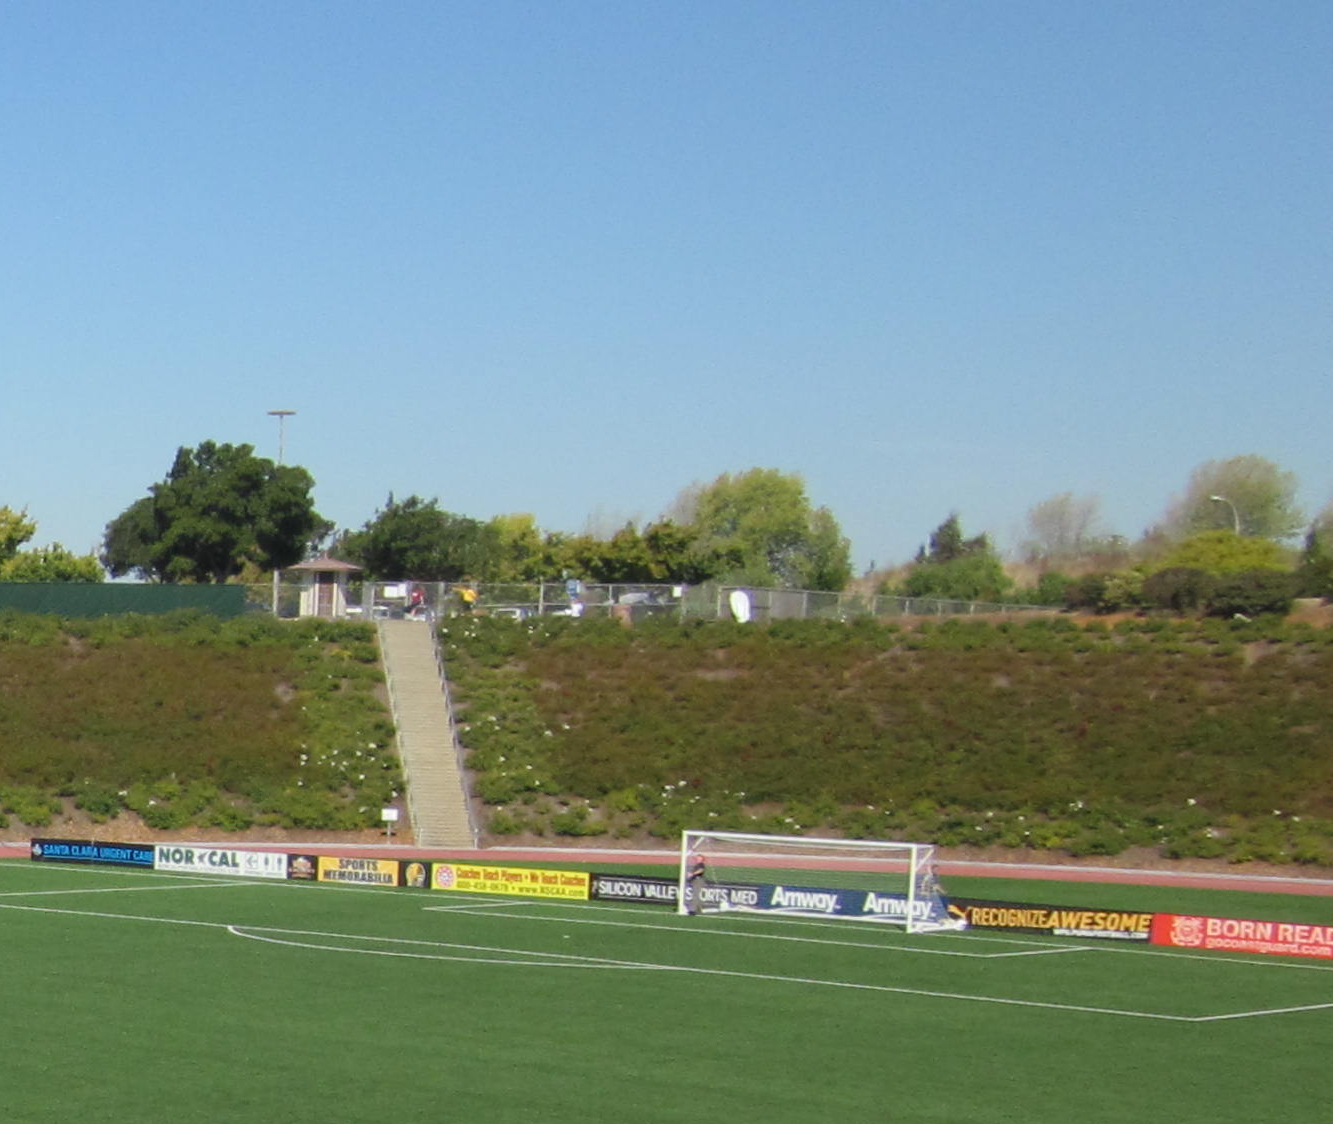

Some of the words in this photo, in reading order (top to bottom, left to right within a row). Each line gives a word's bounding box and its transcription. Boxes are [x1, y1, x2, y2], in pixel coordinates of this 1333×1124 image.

[43, 844, 70, 855] SANTA
[71, 845, 98, 858] CLARA
[99, 847, 132, 860] URGENT
[158, 848, 194, 865] NOR
[207, 851, 239, 868] CAL
[339, 858, 378, 869] SPORTS
[324, 870, 393, 884] MEMORABILIA
[599, 881, 642, 897] SILICON
[685, 887, 729, 902] SORTS
[731, 890, 757, 905] MED
[770, 886, 837, 912] Amway
[971, 908, 1049, 928] RECOGNIZE
[1046, 911, 1152, 932] AWESOME
[1207, 918, 1272, 940] BORN
